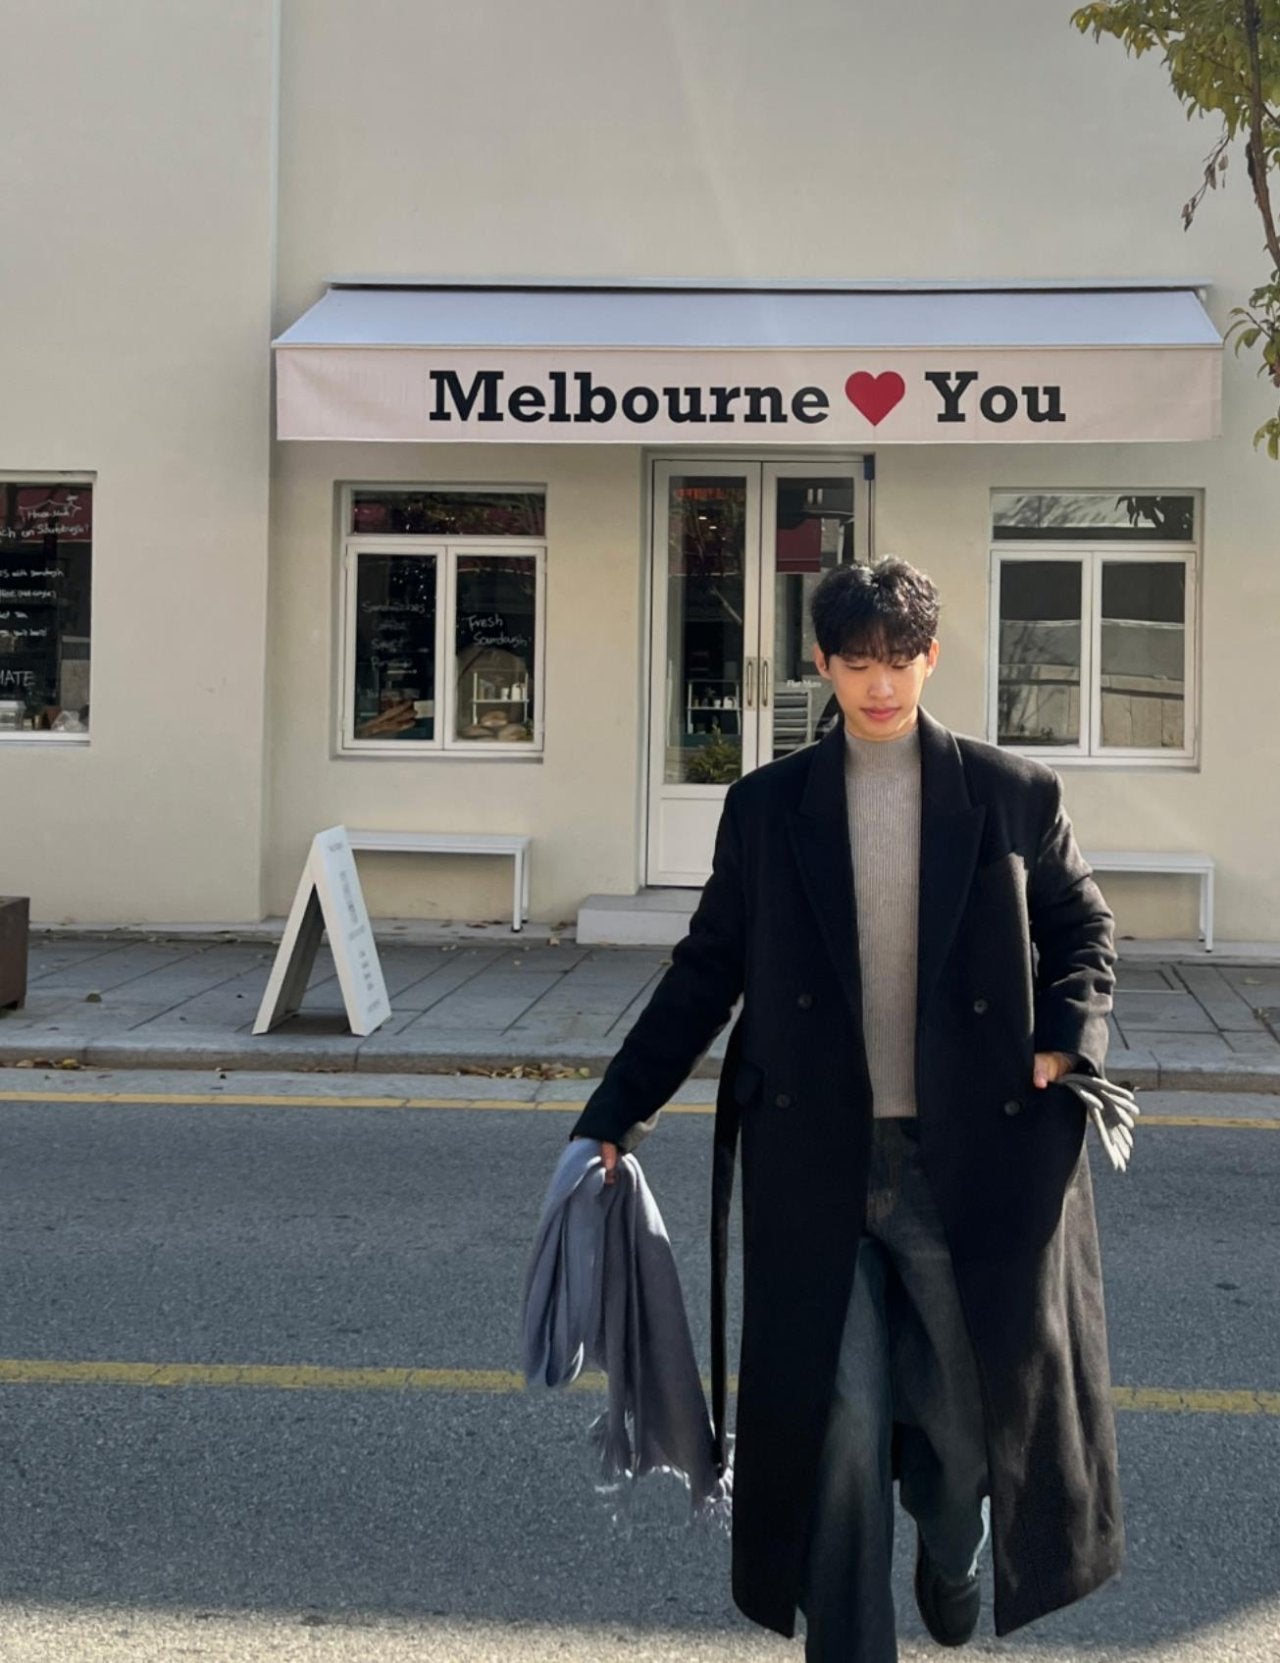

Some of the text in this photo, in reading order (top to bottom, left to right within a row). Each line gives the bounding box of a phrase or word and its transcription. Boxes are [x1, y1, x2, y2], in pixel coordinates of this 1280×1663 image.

[430, 371, 1065, 423] Melbourne You
[461, 613, 504, 631] Fresh
